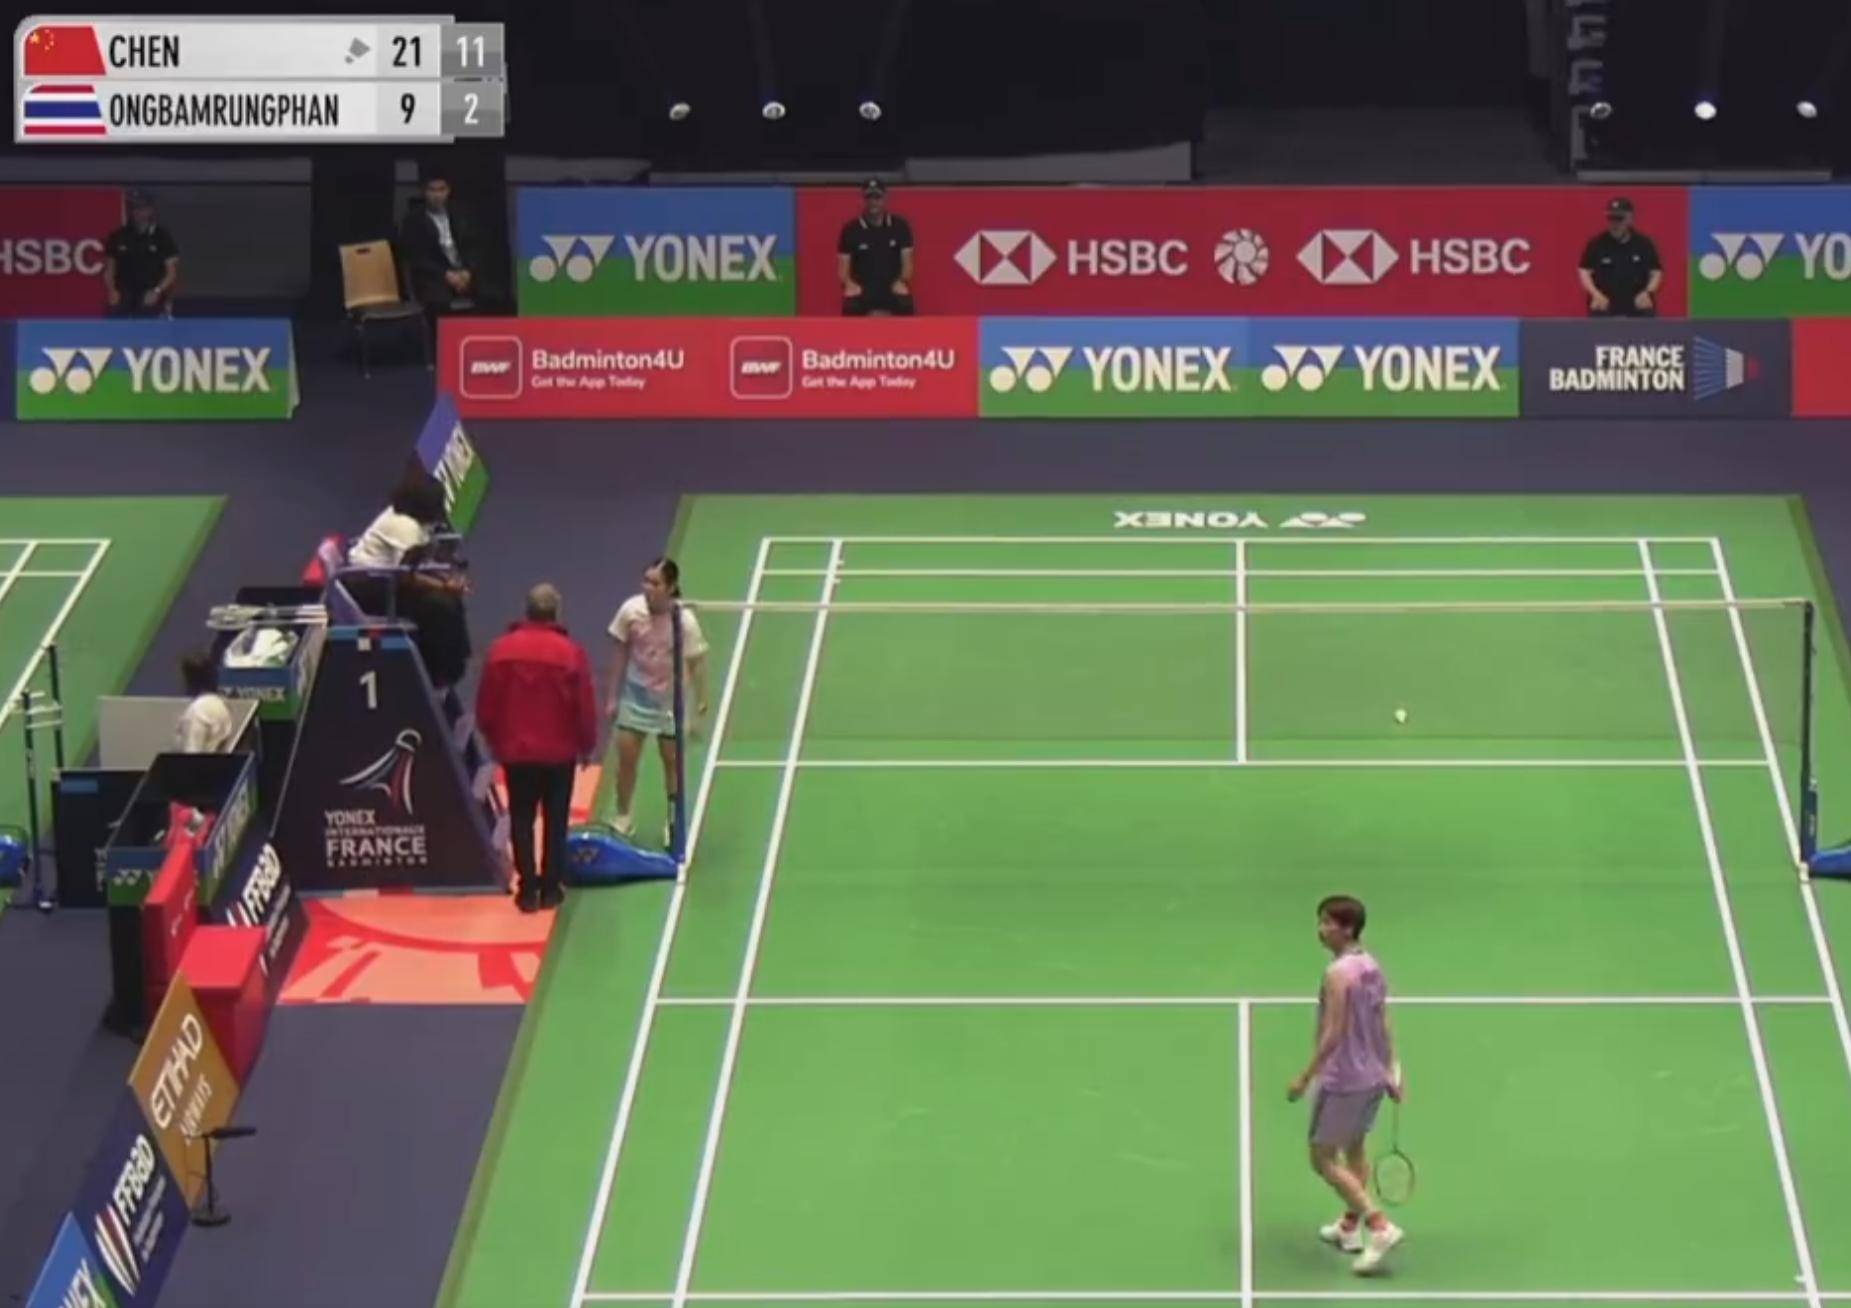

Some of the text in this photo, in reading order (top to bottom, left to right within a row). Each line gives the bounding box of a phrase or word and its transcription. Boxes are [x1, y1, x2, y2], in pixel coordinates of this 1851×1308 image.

[624, 234, 778, 282] YONEX
[1067, 239, 1188, 276] HSBC
[1410, 239, 1531, 275] HSBC
[532, 349, 684, 369] Badminton4U
[802, 349, 954, 369] Badminton4U
[1596, 345, 1684, 367] FRANCE
[122, 347, 271, 393] YONEX
[1084, 346, 1232, 391] YONEX
[1354, 345, 1501, 391] YONEX
[1550, 368, 1684, 391] BADMINTON
[532, 376, 646, 389] Get the App Today
[802, 376, 917, 389] Get the App Today
[1113, 511, 1269, 529] YONEX
[359, 671, 378, 709] 1
[325, 809, 376, 825] YONEX
[326, 837, 427, 857] FRANCE
[152, 1013, 203, 1130] ETIHAD
